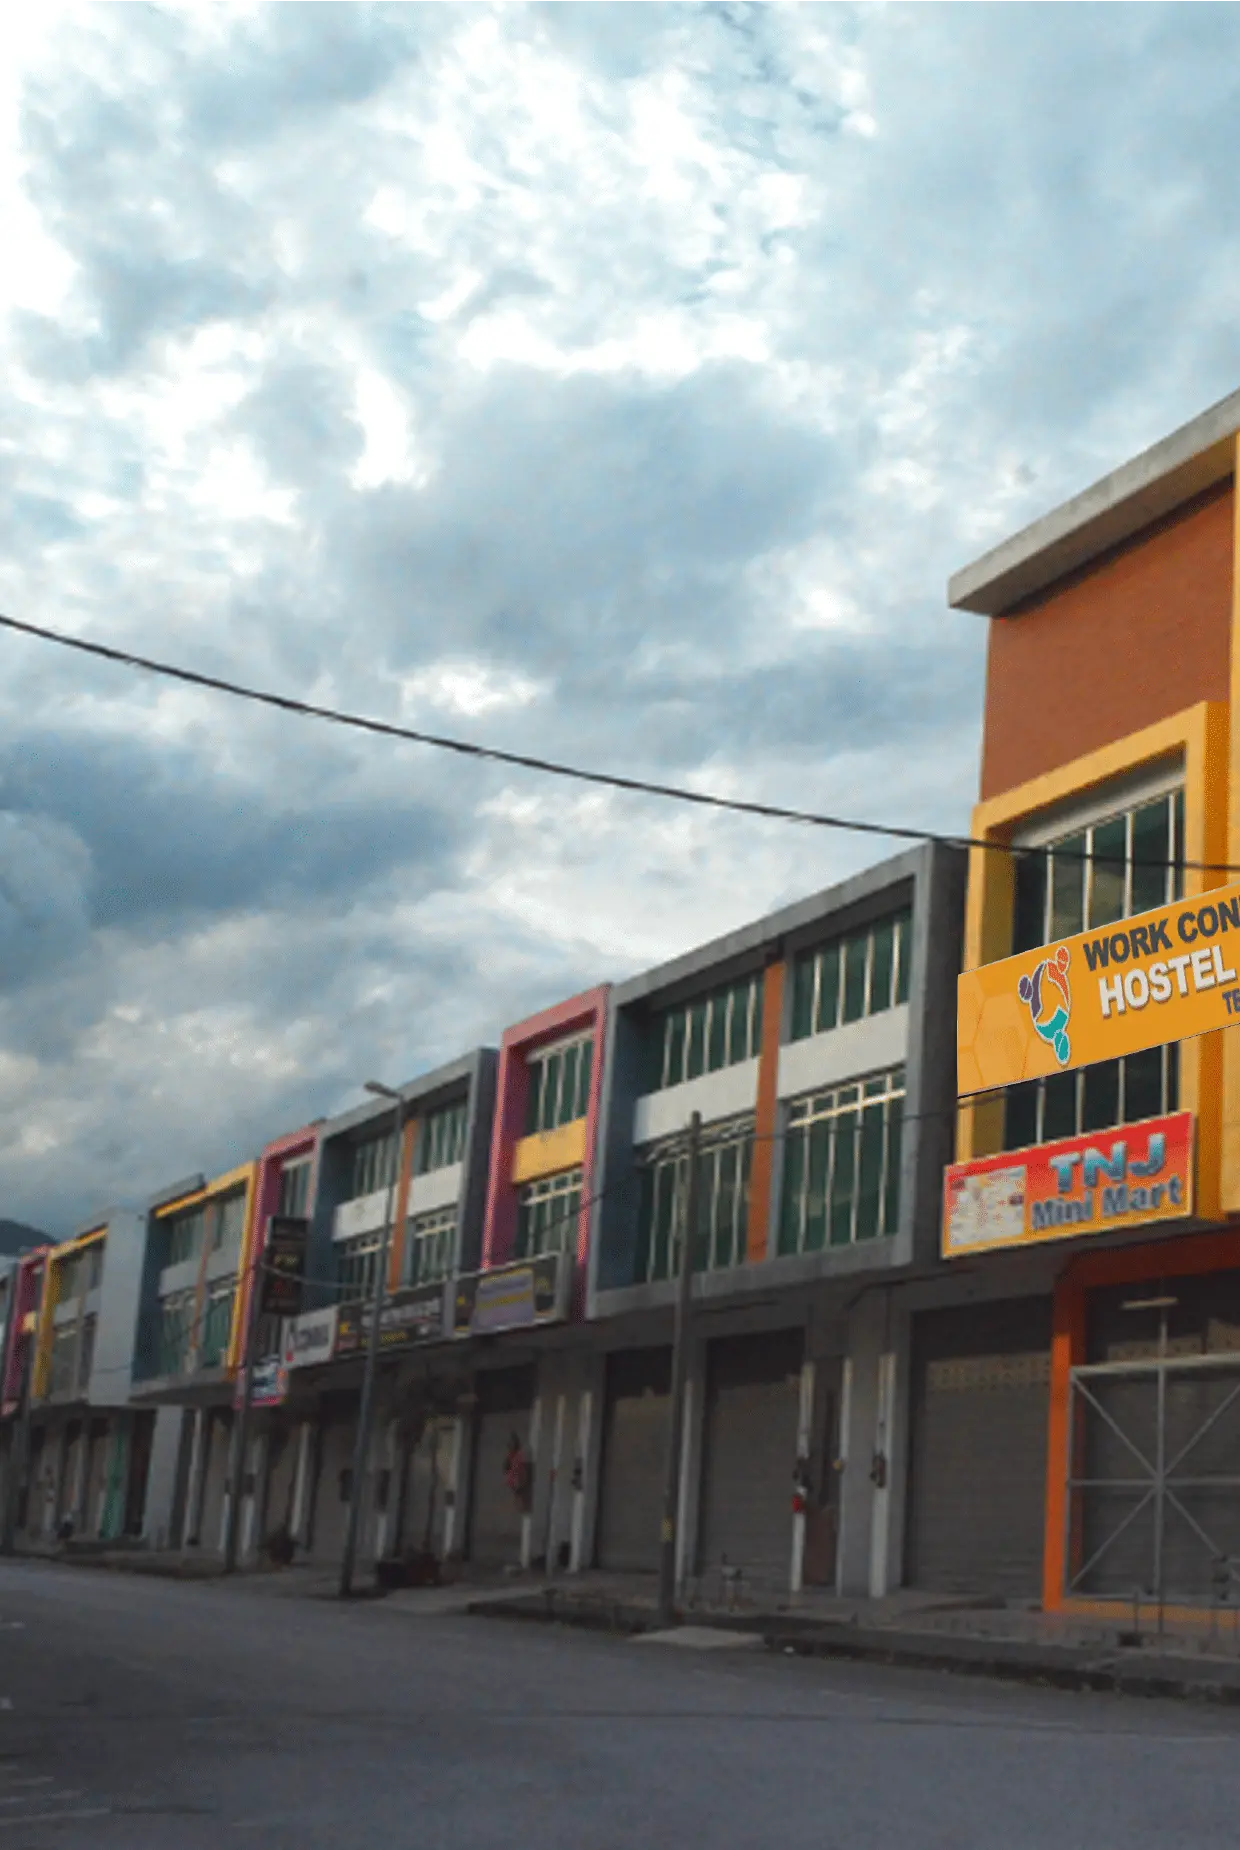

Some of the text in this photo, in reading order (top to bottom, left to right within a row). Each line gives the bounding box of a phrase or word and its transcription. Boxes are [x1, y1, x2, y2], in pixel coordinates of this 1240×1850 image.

[1083, 918, 1173, 971] WORK
[1098, 945, 1238, 1018] HOSTEL
[1049, 1132, 1166, 1193] TNJ
[1031, 1189, 1093, 1230] Mini
[1102, 1175, 1181, 1218] Mart
